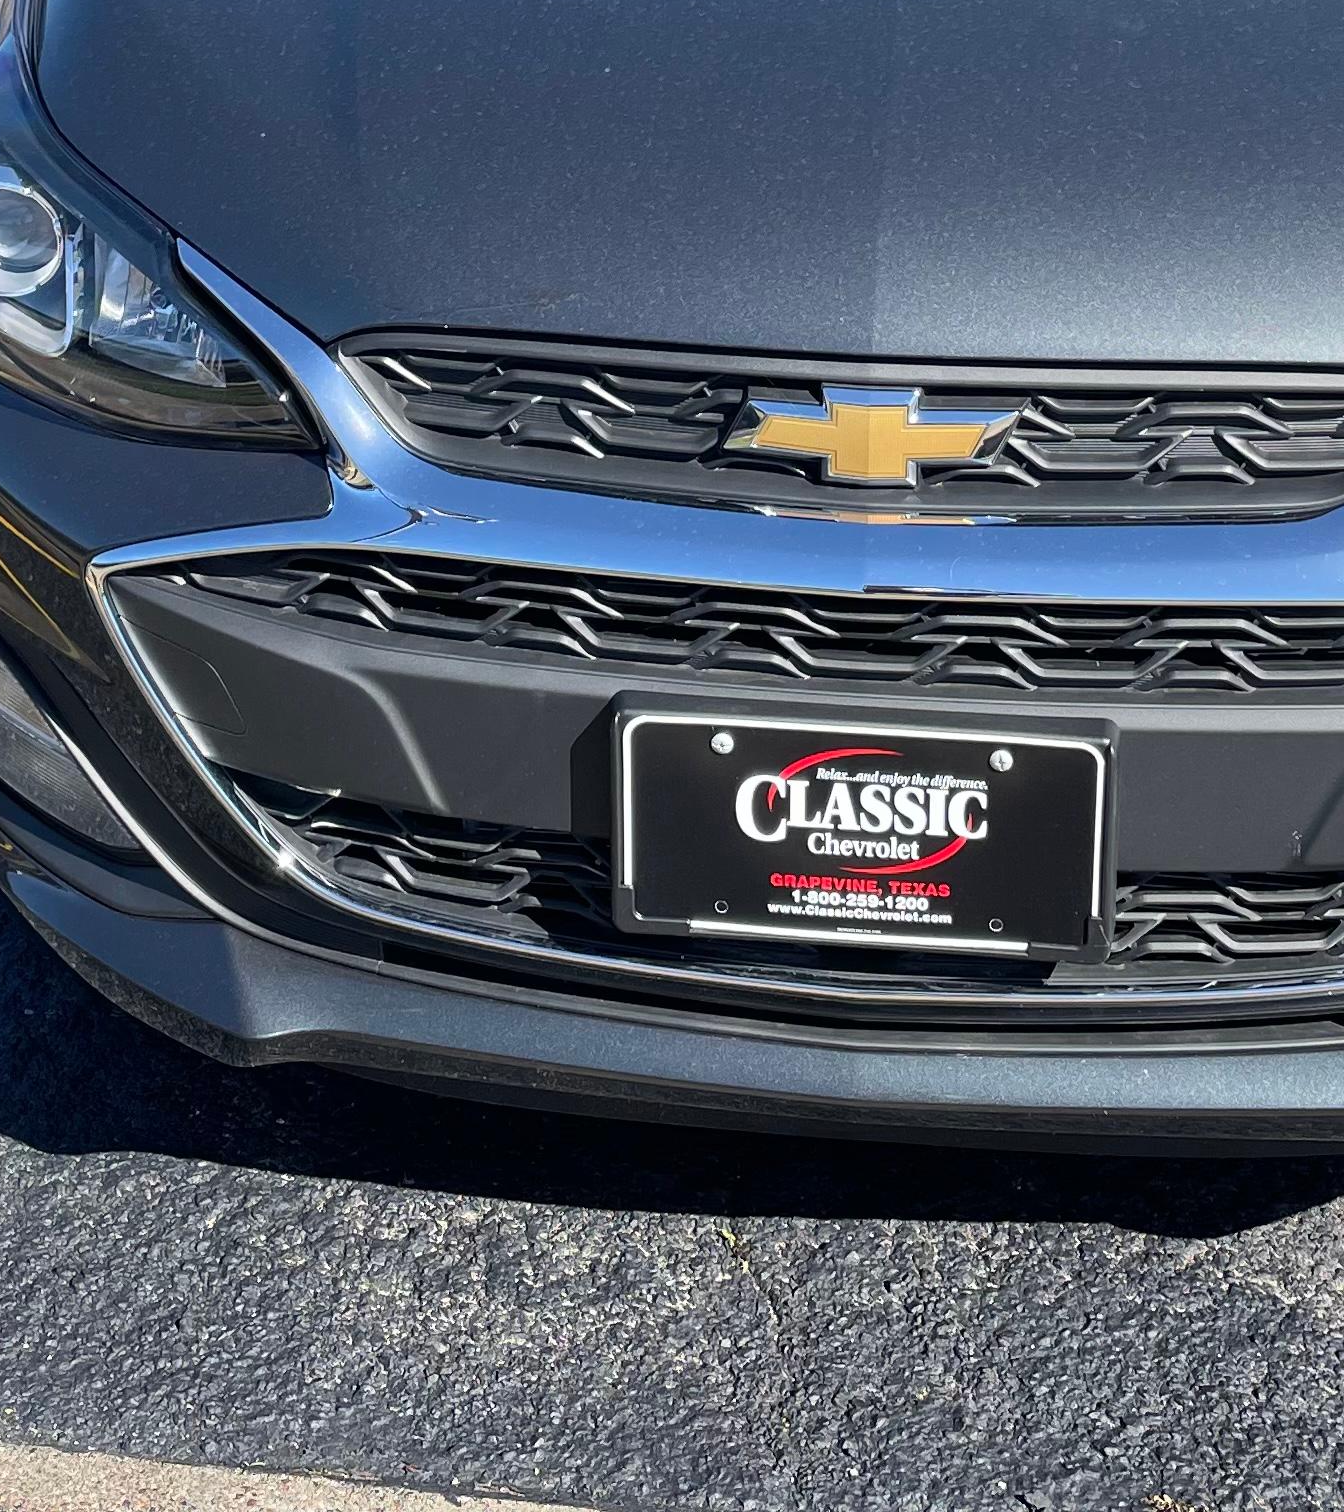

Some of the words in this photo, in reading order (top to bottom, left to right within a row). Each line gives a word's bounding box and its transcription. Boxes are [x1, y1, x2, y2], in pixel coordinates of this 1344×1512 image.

[879, 772, 912, 787] enjoy
[911, 773, 930, 786] the
[735, 774, 989, 842] CLASSIC
[807, 832, 920, 860] Chevrolet
[770, 873, 883, 895] GRAPEVINE,
[889, 880, 951, 897] TEXAS
[791, 889, 929, 911] 1-800-259-1200
[767, 903, 953, 925] www.ClassicChevrolet.com
